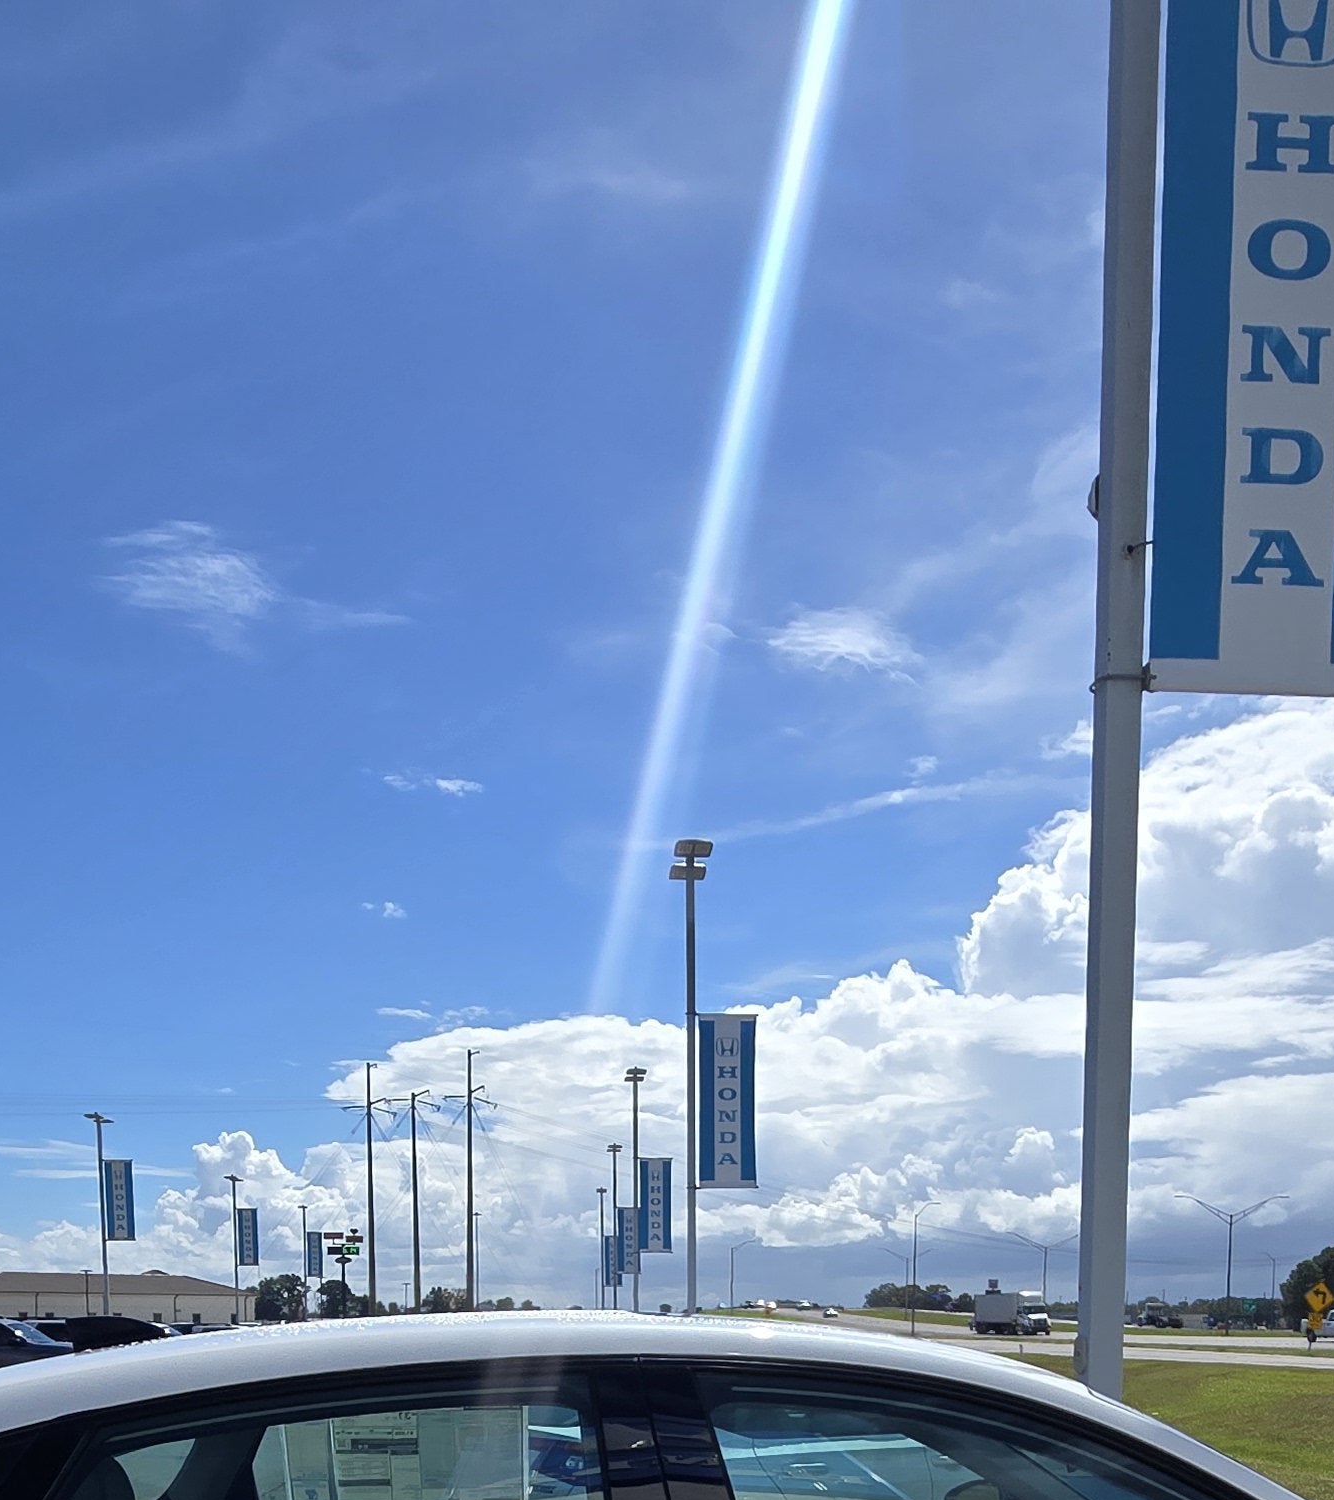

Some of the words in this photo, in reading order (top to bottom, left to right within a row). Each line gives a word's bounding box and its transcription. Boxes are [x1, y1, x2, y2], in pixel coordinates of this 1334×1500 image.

[717, 1065, 738, 1166] HONDA
[114, 1183, 126, 1231] HONDA
[650, 1185, 662, 1242] HONDA
